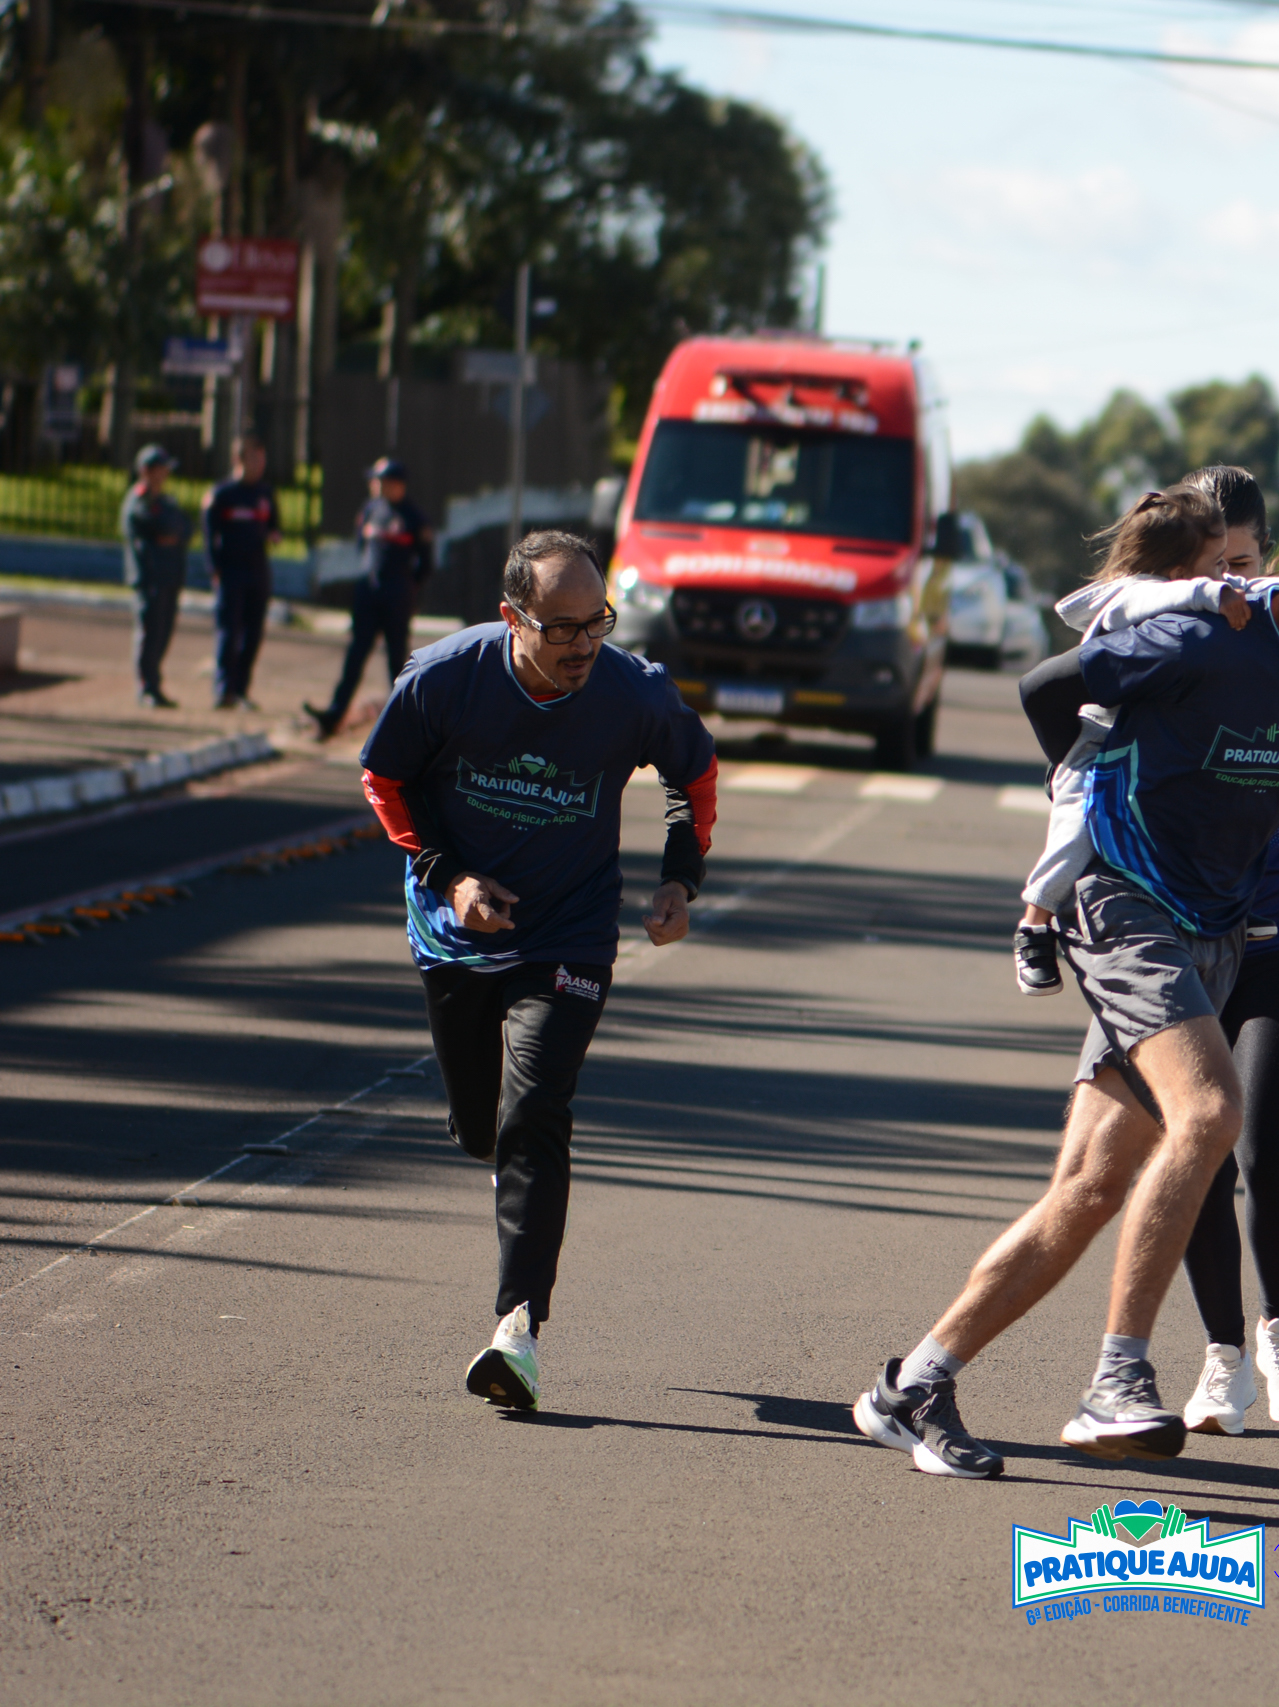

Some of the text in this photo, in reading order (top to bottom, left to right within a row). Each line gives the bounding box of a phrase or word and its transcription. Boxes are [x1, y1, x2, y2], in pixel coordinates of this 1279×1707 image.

[470, 771, 541, 796] PRATIQUE
[466, 796, 512, 819] EDUCAÇÃO
[512, 811, 542, 825] FÍSICA
[552, 813, 577, 825] AÇÃO
[562, 974, 600, 993] AASLO
